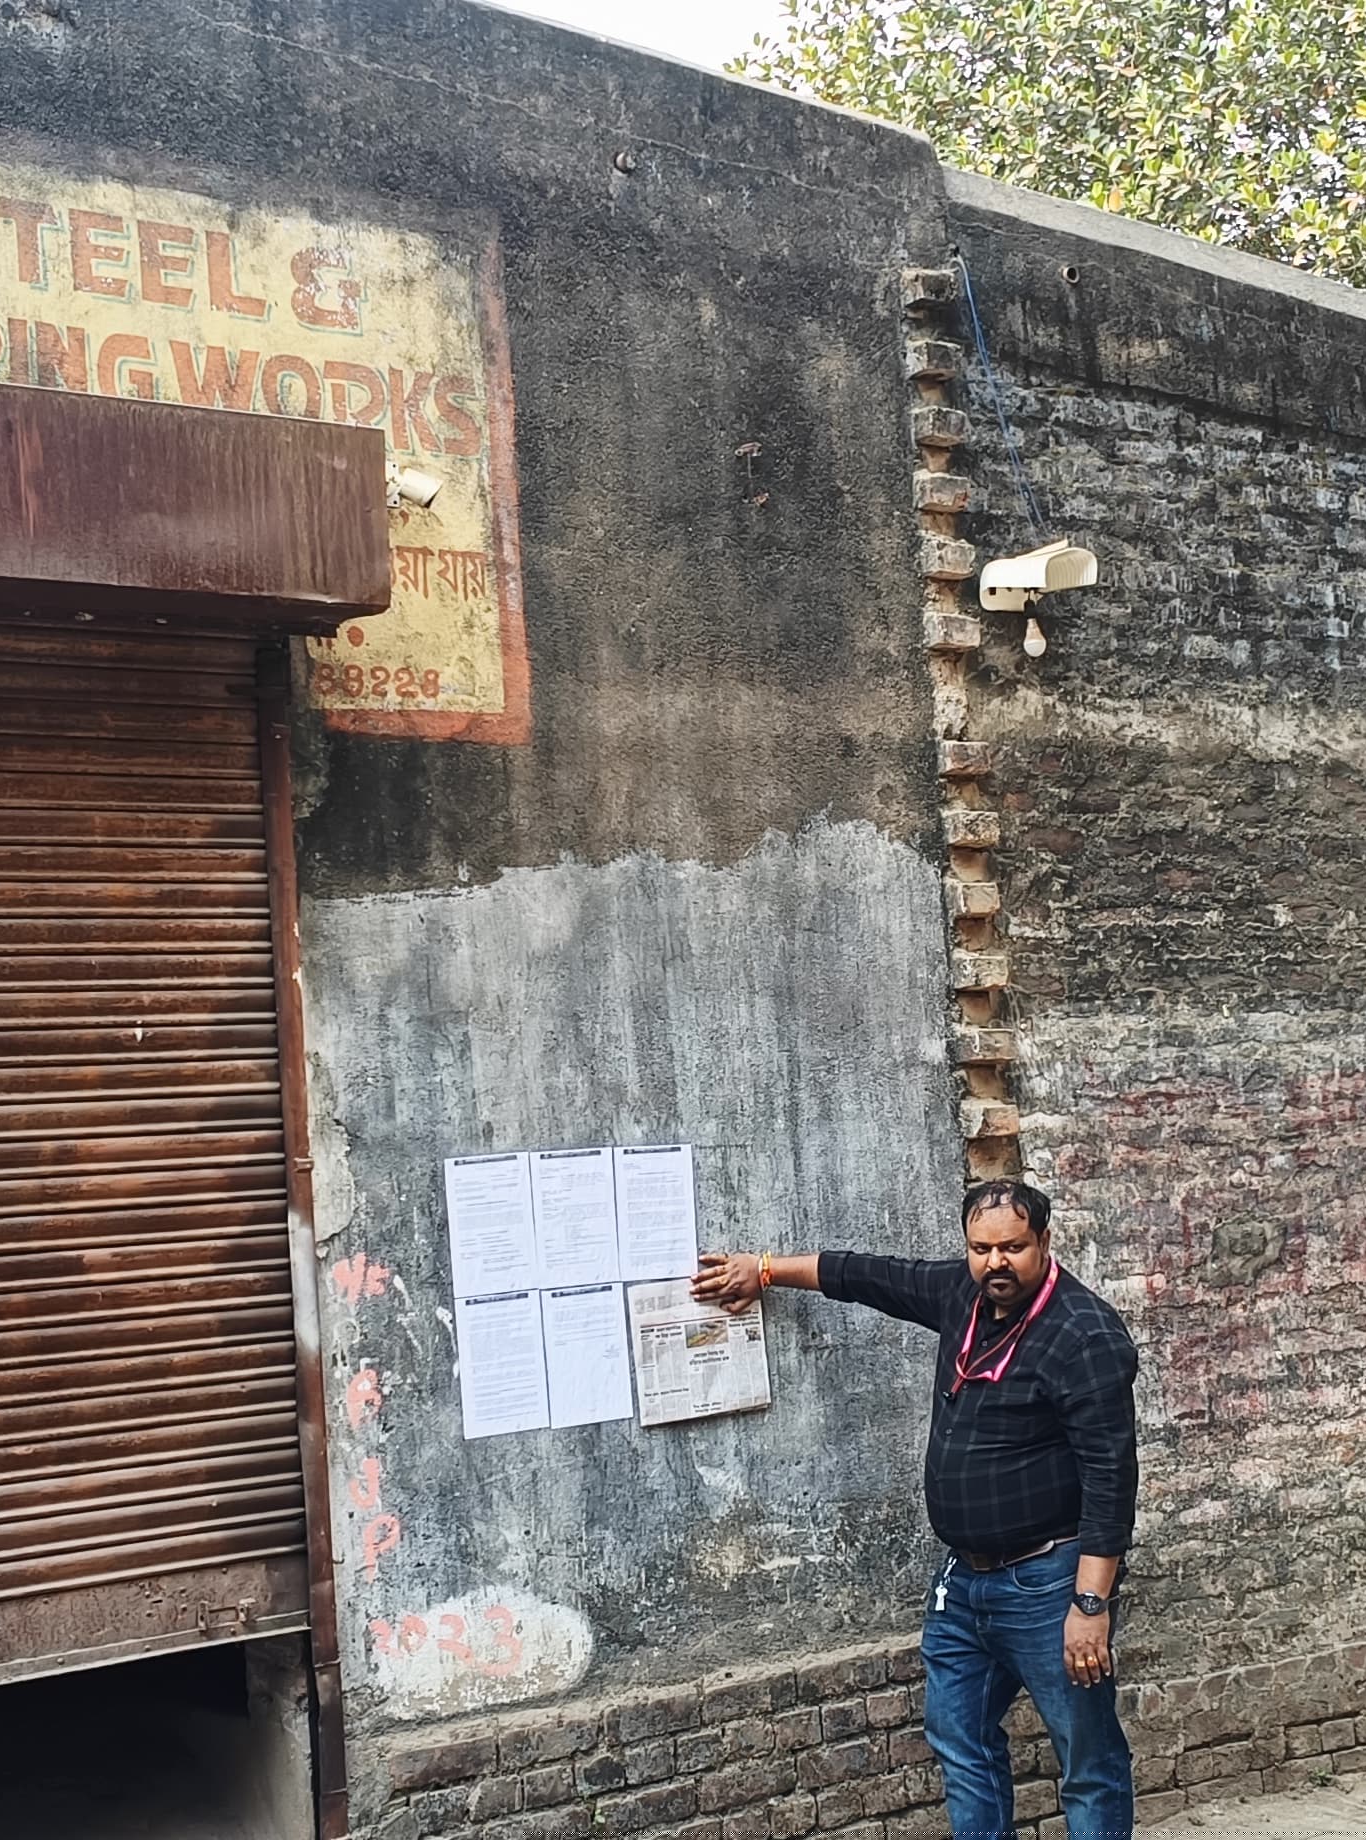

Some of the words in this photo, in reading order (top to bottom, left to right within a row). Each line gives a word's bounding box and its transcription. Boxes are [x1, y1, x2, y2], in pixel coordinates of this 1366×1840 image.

[290, 246, 366, 334] &
[169, 339, 483, 456] WORKS
[368, 1604, 524, 1677] 2023
